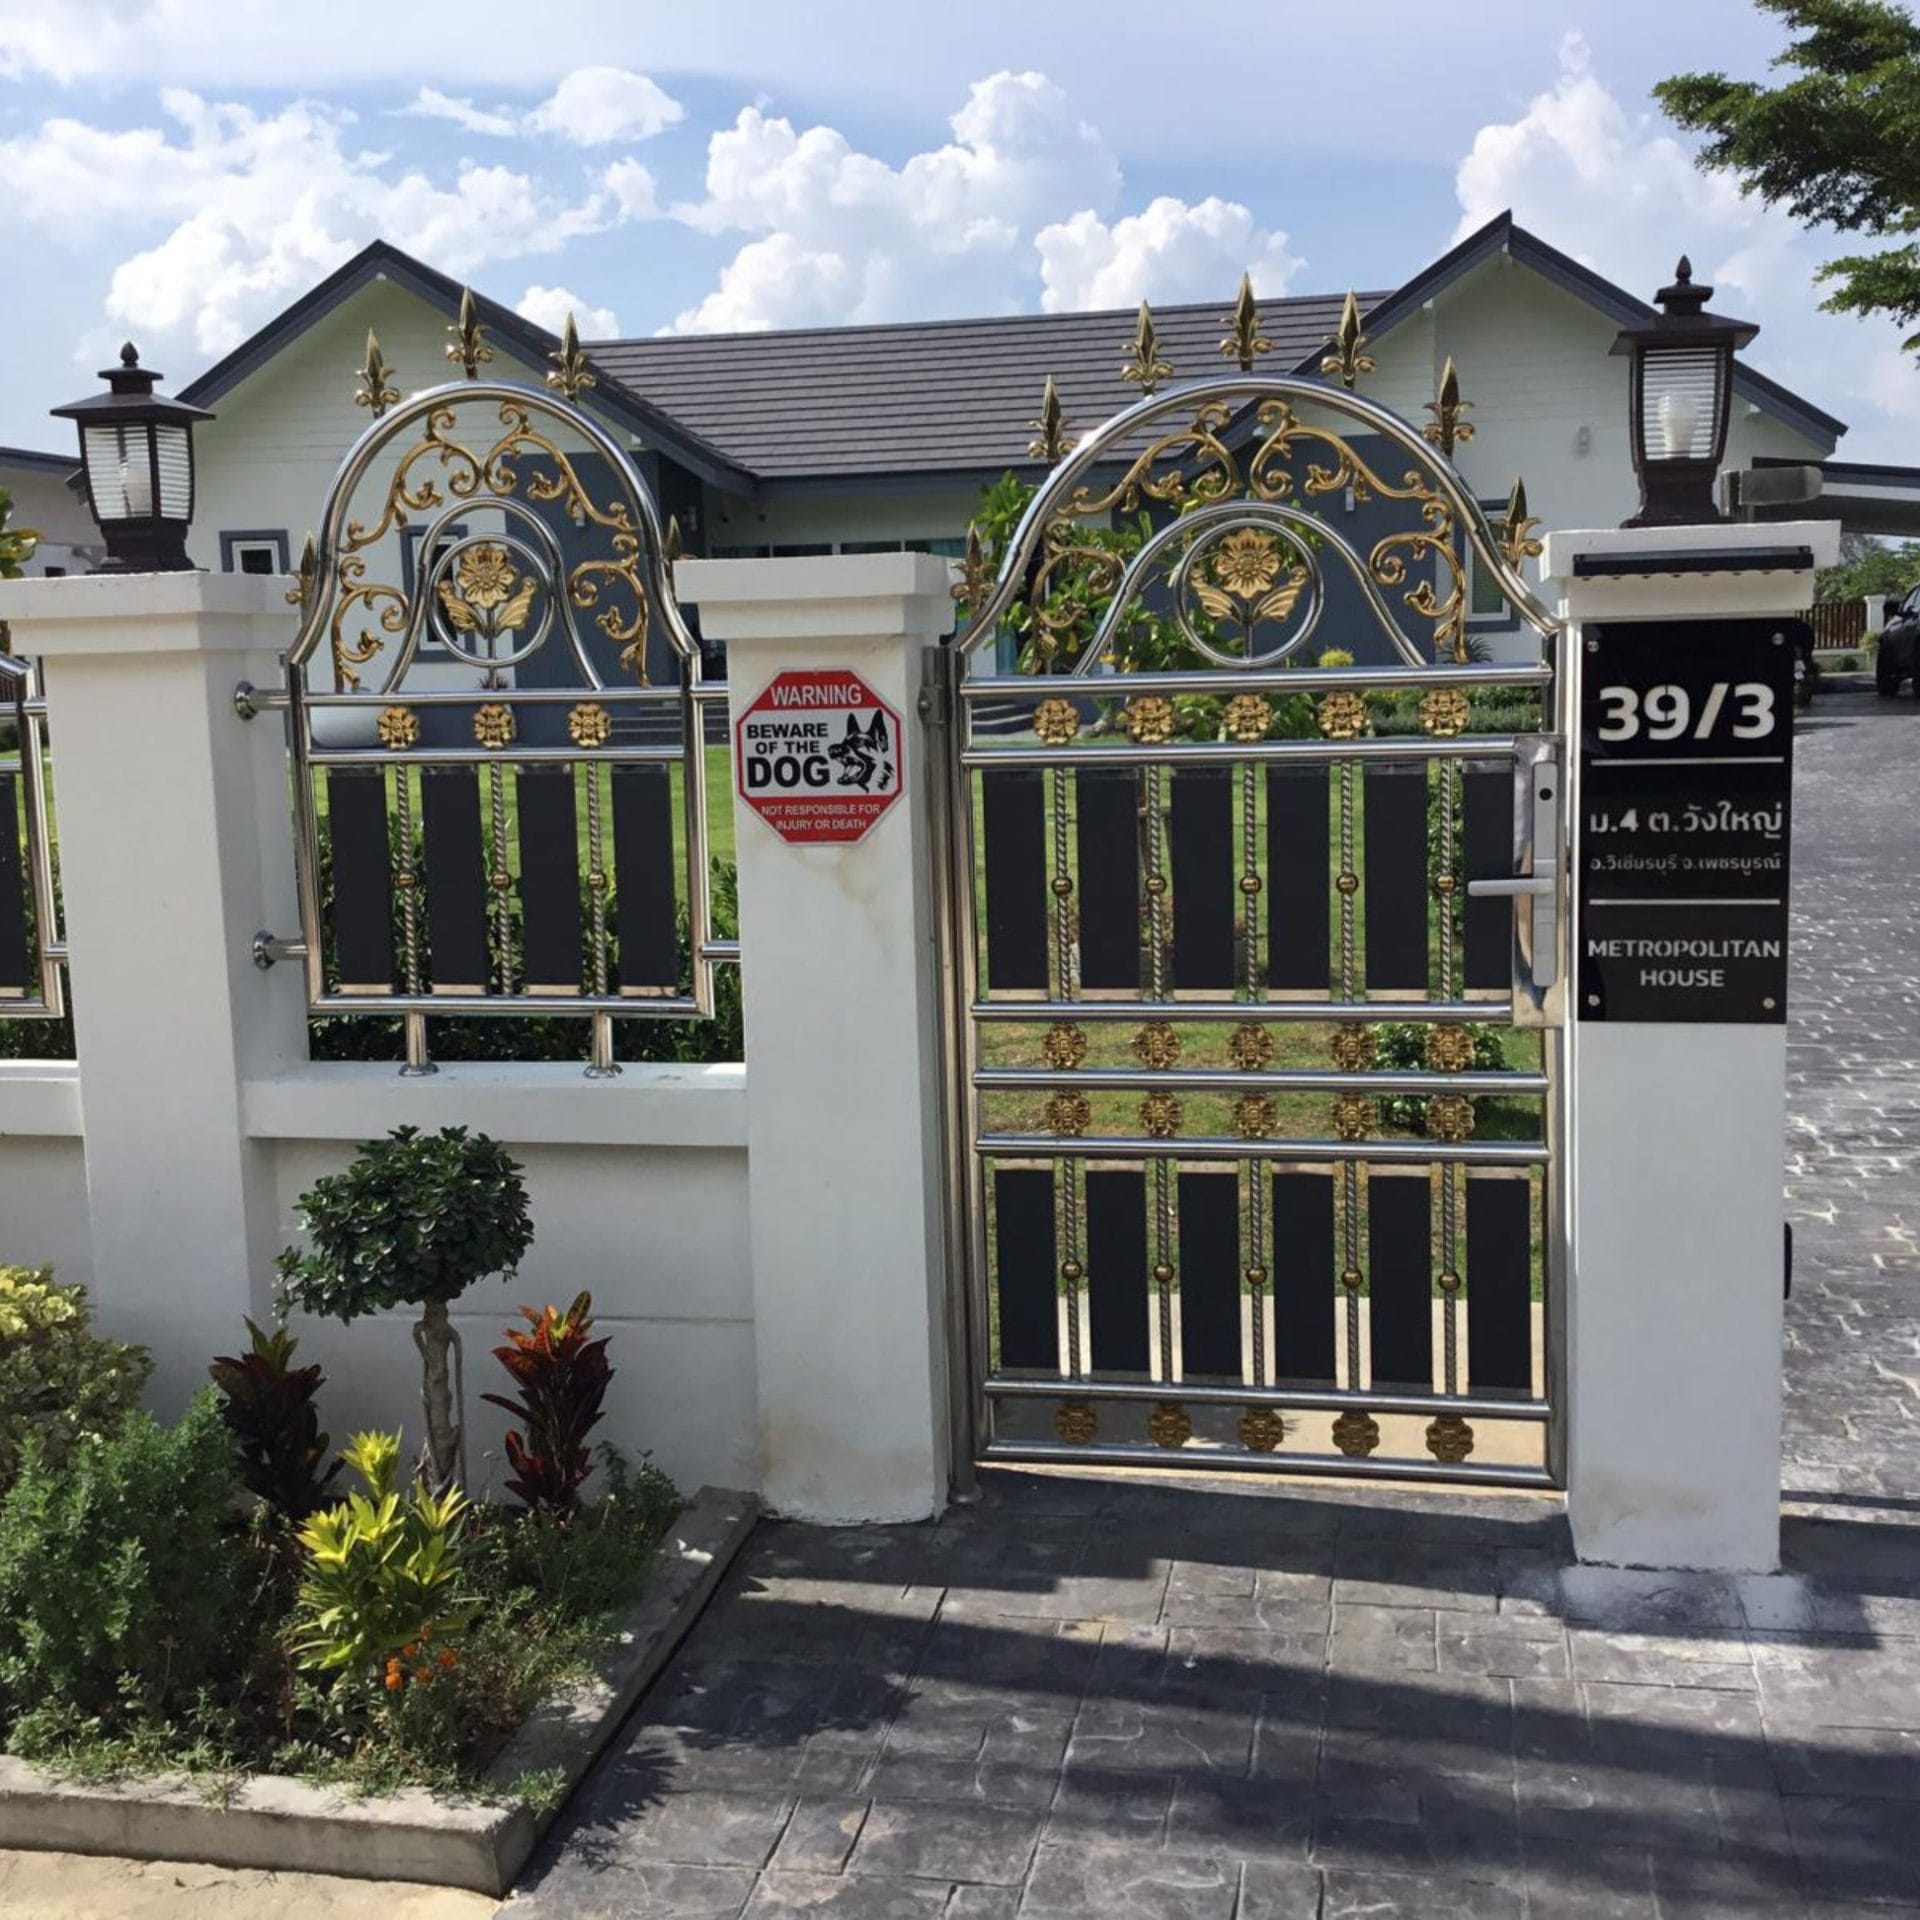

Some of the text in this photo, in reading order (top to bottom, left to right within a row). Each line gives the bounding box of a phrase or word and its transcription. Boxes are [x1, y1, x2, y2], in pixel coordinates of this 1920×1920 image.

[770, 684, 863, 706] WARNING
[1598, 682, 1776, 742] 39/3
[746, 723, 829, 739] BEWARE
[755, 740, 820, 755] OF THE
[747, 756, 831, 788] DOG
[761, 804, 881, 816] NOT RESPONSIBLE FOR
[1590, 800, 1783, 839] ม.4 ต.วังใหญ่
[775, 819, 867, 830] INJURY OR DEATH
[1587, 939, 1781, 959] METROPOLITAN
[1639, 968, 1726, 988] HOUSE
